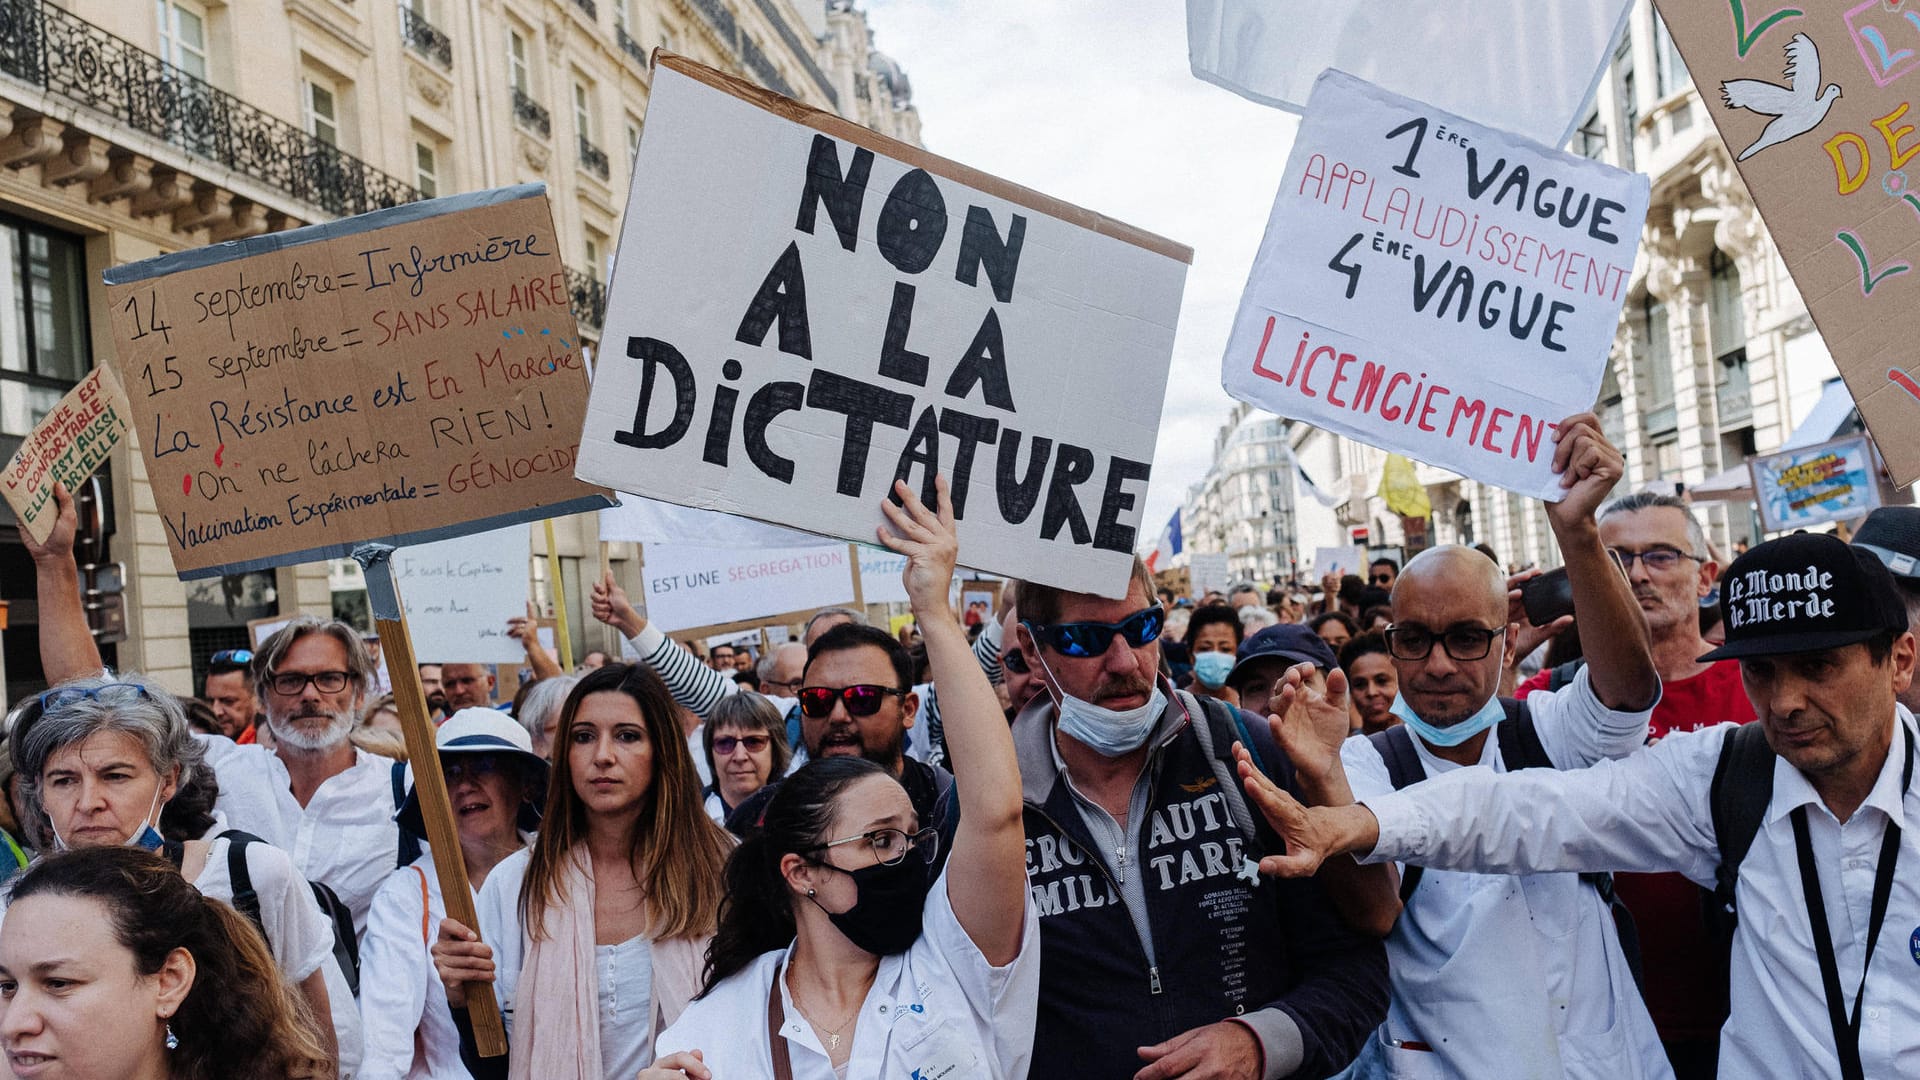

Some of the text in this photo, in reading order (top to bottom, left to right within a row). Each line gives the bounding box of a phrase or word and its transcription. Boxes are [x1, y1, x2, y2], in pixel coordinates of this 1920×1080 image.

[795, 133, 1026, 303] NON
[1466, 147, 1627, 245] VAGUE
[124, 290, 172, 344] 14
[194, 262, 338, 341] septembre
[734, 239, 1016, 413] A LA
[1412, 254, 1576, 352] VAGUE
[78, 369, 101, 404] EST
[141, 356, 183, 397] 15
[208, 327, 338, 390] septembre
[373, 303, 450, 347] SANS
[154, 413, 200, 458] La
[209, 387, 357, 445] Résistance
[373, 371, 416, 408] est
[424, 360, 463, 400] En
[24, 483, 50, 523] ELLE
[51, 447, 74, 481] EST
[197, 470, 242, 500] On
[258, 462, 299, 486] ne
[164, 506, 282, 550] Vaccination
[652, 576, 681, 594] EST
[685, 570, 721, 588] UNE
[1728, 565, 1833, 604] Le Monde
[1730, 591, 1836, 629] de Merde
